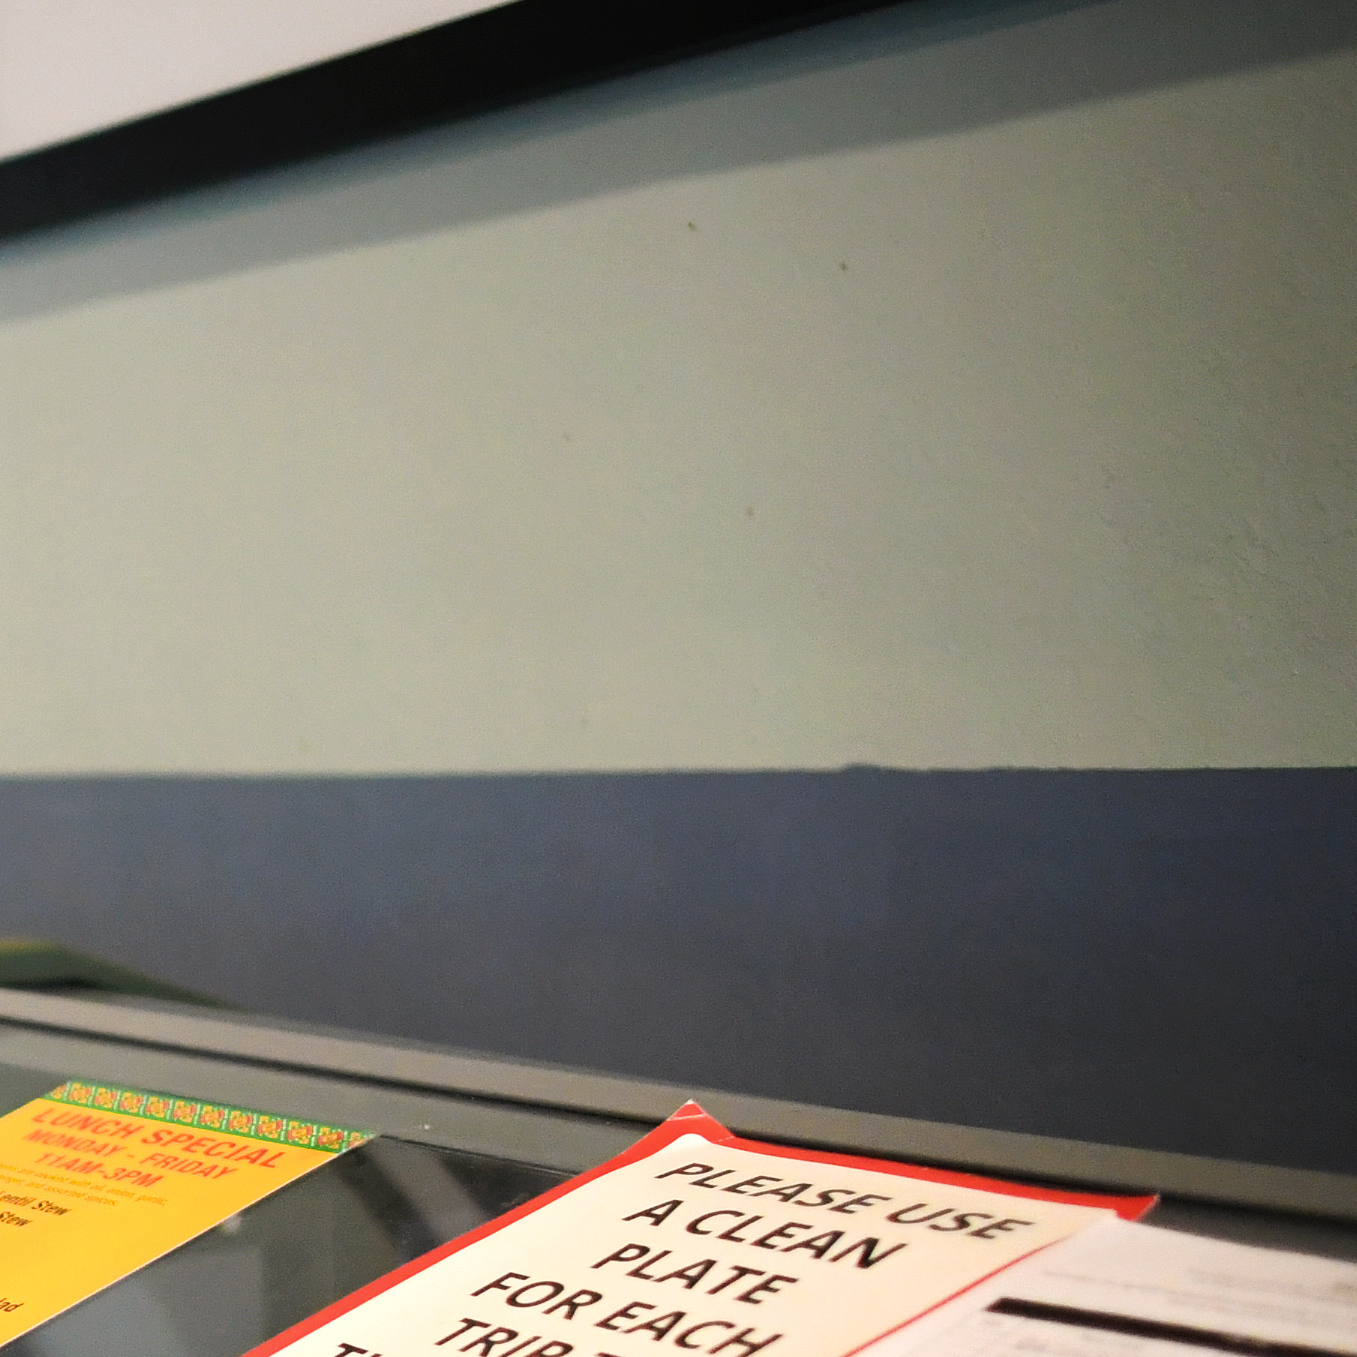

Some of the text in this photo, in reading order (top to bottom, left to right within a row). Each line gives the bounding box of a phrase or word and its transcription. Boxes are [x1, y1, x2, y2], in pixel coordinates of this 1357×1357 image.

[24, 1129, 127, 1156] MONDAY
[140, 1153, 238, 1180] FRIDAY
[31, 1108, 285, 1168] LUNCH SPECIAL
[35, 1153, 163, 1187] 11AM-3PM
[31, 1199, 72, 1216] Stew
[655, 1162, 1033, 1240] PLEASE USE
[620, 1198, 907, 1270] A CLEAN
[471, 1271, 604, 1321] FOR
[590, 1242, 799, 1306] PLATE
